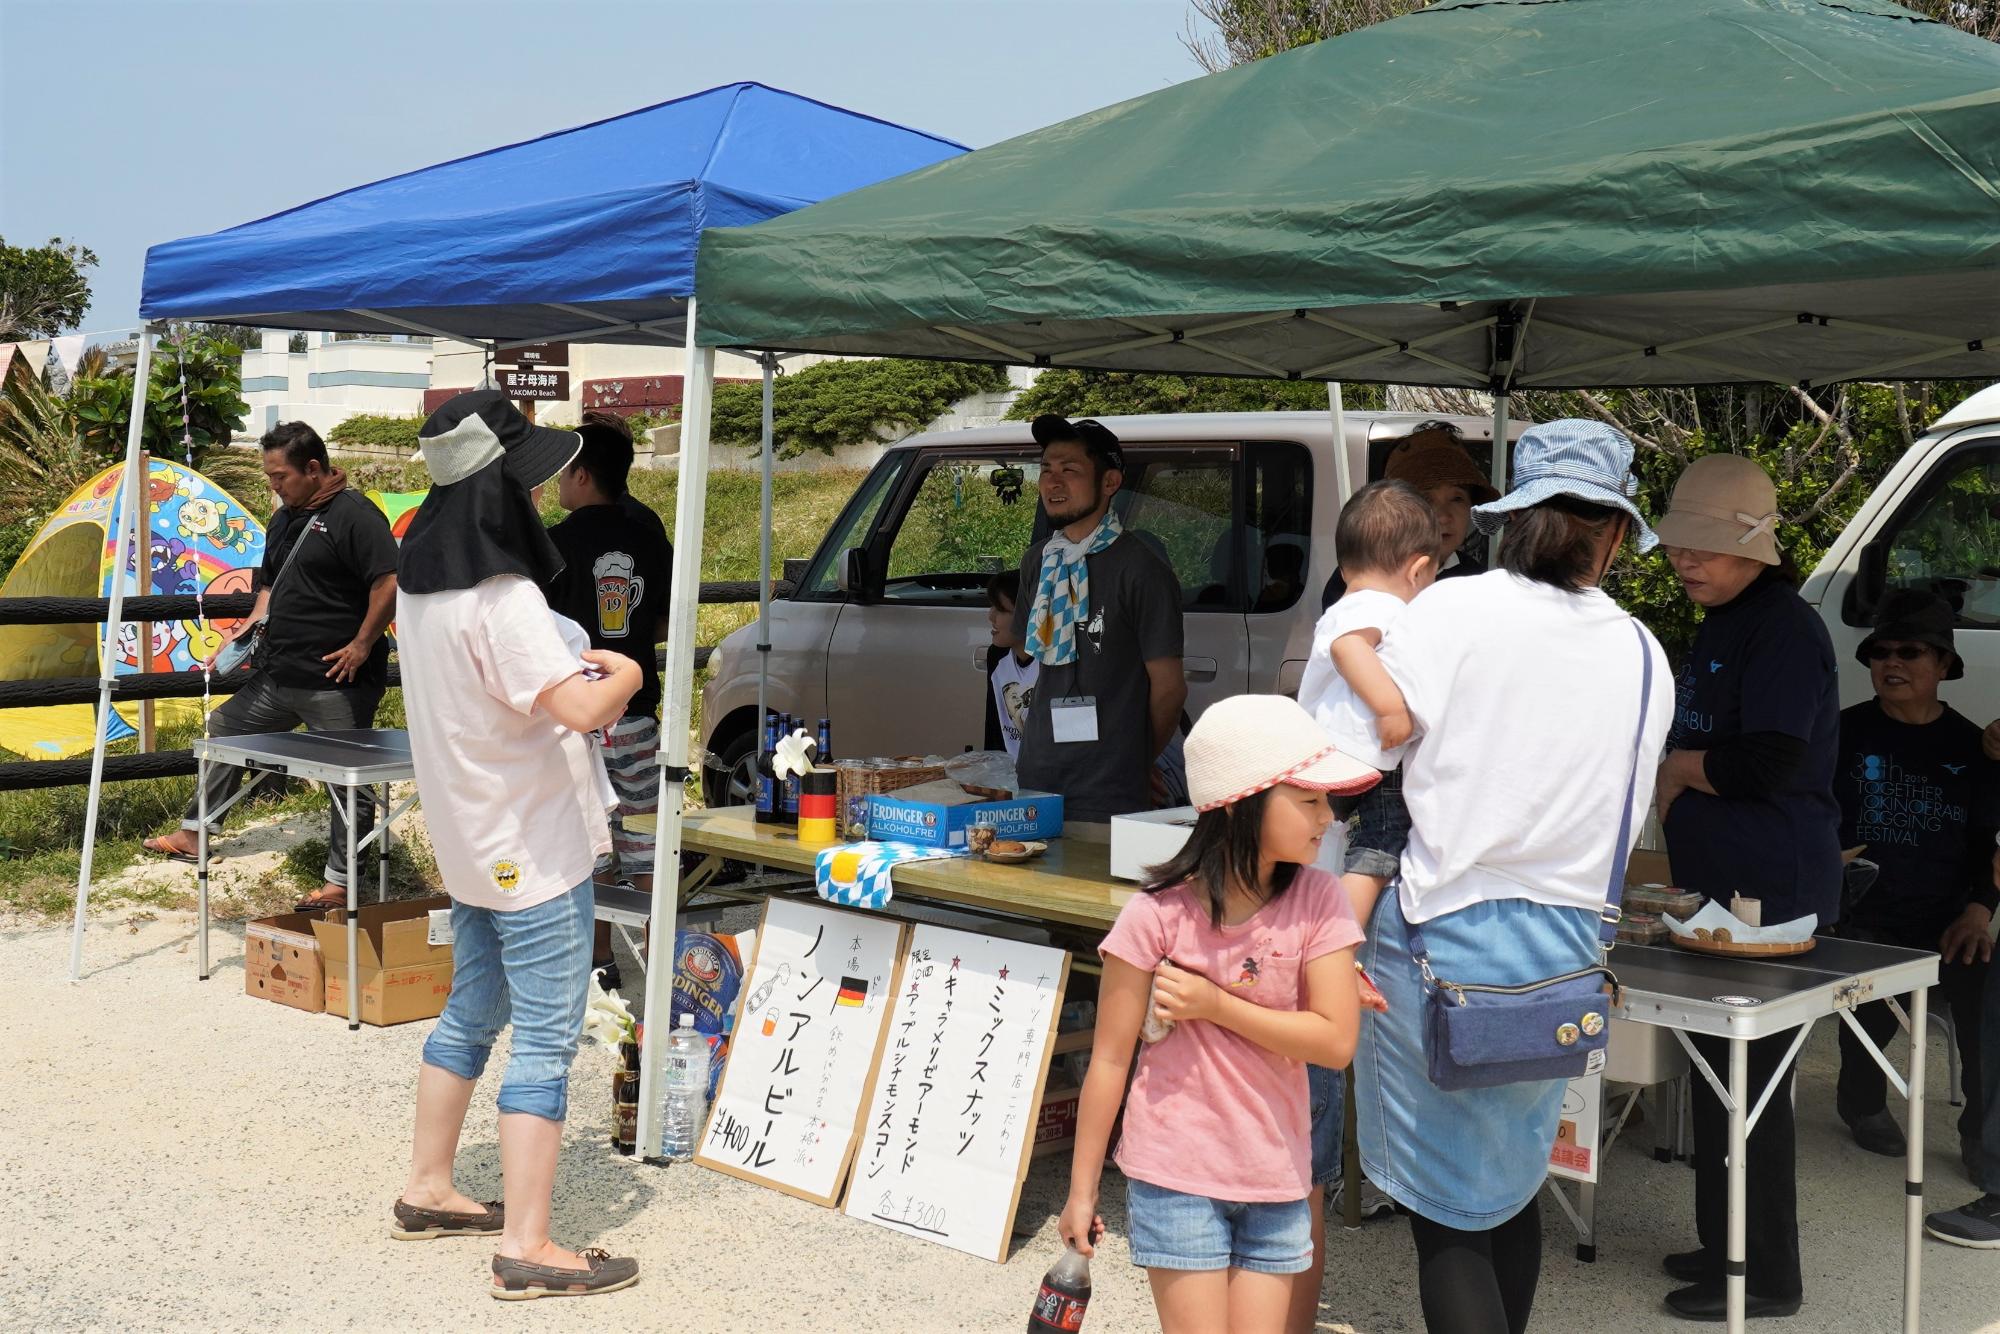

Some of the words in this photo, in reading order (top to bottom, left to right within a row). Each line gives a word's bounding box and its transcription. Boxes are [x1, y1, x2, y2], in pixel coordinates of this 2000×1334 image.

[507, 373, 558, 387] 屋子母海岸
[539, 389, 557, 397] Beach
[598, 582, 630, 596] SWAT
[605, 597, 622, 612] 19
[1850, 752, 1904, 782] 38th
[1855, 779, 1944, 802] TOGETHER
[872, 803, 924, 826] ERDINGER
[974, 806, 1026, 823] ERDINGER
[1856, 807, 1942, 832] JOGGING
[871, 823, 936, 838] ALKOHOLFREI
[1855, 825, 1920, 847] FESTIVAL
[690, 946, 720, 972] ERDINGER
[847, 934, 863, 973] 本場
[911, 949, 932, 965] 限定
[672, 973, 724, 1022] DINGER
[742, 924, 824, 1169] ノンアルビール
[900, 974, 958, 1176] キャラメリゼアーモンド
[956, 985, 1006, 1157] ミックスナッツ
[867, 992, 920, 1180] アップルシナモンスコーン
[710, 1107, 750, 1153] ¥400
